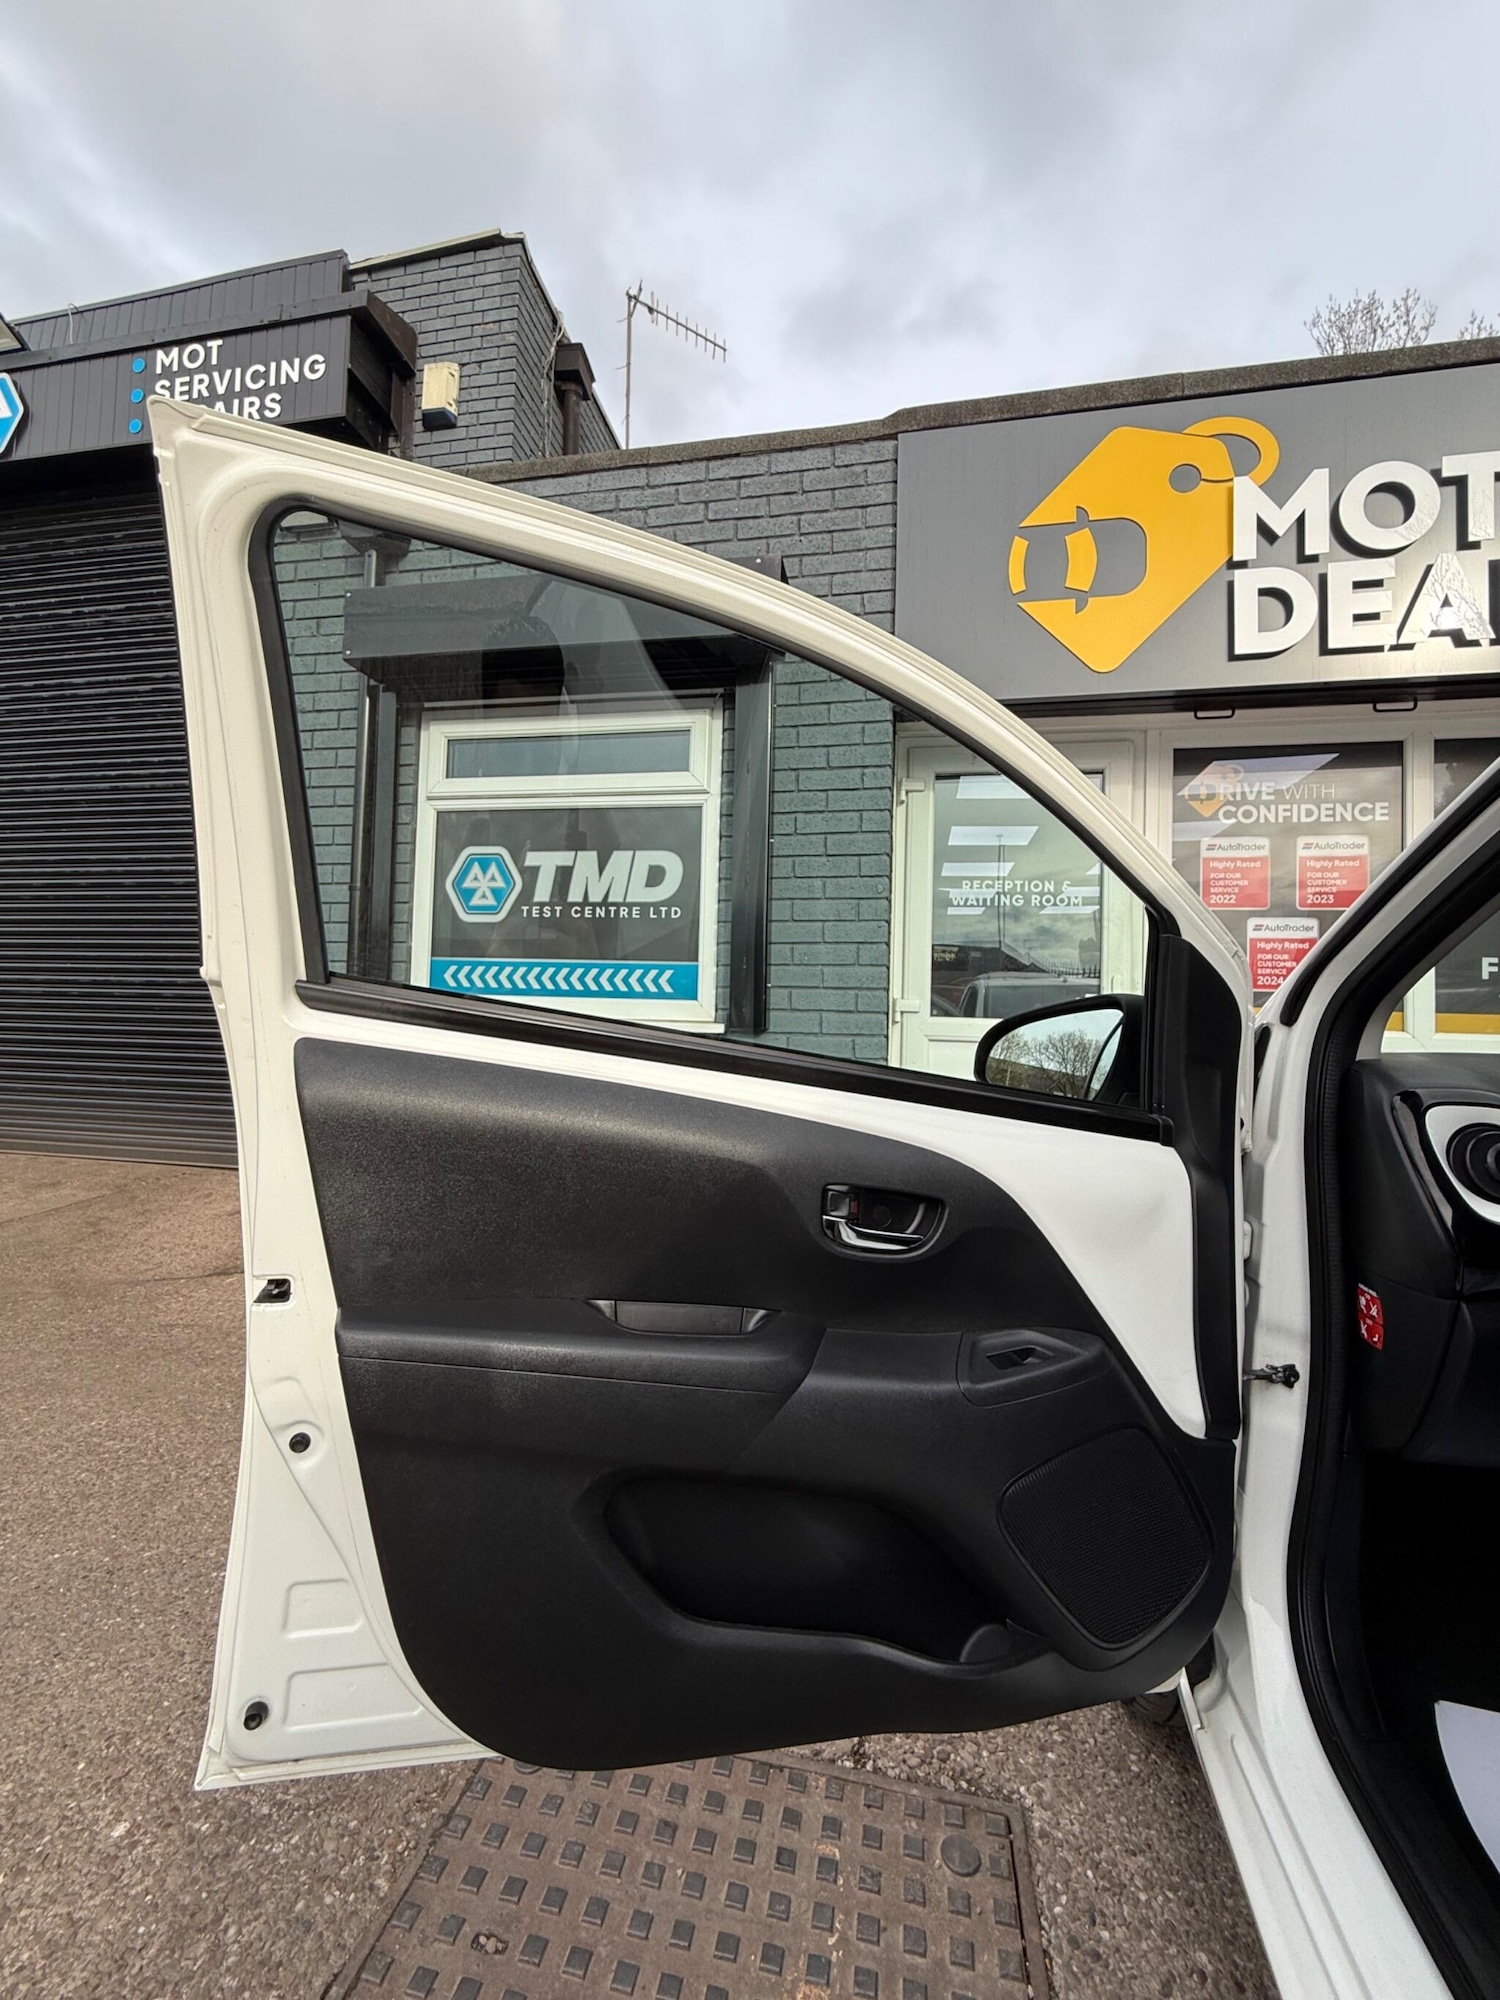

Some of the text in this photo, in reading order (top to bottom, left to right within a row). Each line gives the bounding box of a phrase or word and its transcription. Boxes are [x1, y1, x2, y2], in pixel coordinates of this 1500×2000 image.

[155, 339, 223, 375] MOT
[154, 353, 326, 400] SERVICING
[1283, 783, 1335, 800] WITH
[1218, 801, 1390, 824] CONFIDENCE
[1217, 843, 1266, 851] AutoTrader
[1314, 841, 1365, 850] AutoTrader
[1209, 860, 1261, 869] Highly Rated
[1306, 859, 1360, 868] Highly Rated
[523, 850, 684, 903] TMD
[962, 880, 1072, 893] RECEPTION &
[951, 894, 1083, 907] WAITING ROOM
[1210, 895, 1236, 904] 2022
[1306, 894, 1335, 904] 2023
[521, 905, 682, 919] TEST CENTRE LTD
[1264, 924, 1314, 932] AutoTrader
[1256, 941, 1310, 950] Highly Rated
[1256, 976, 1284, 985] 2024
